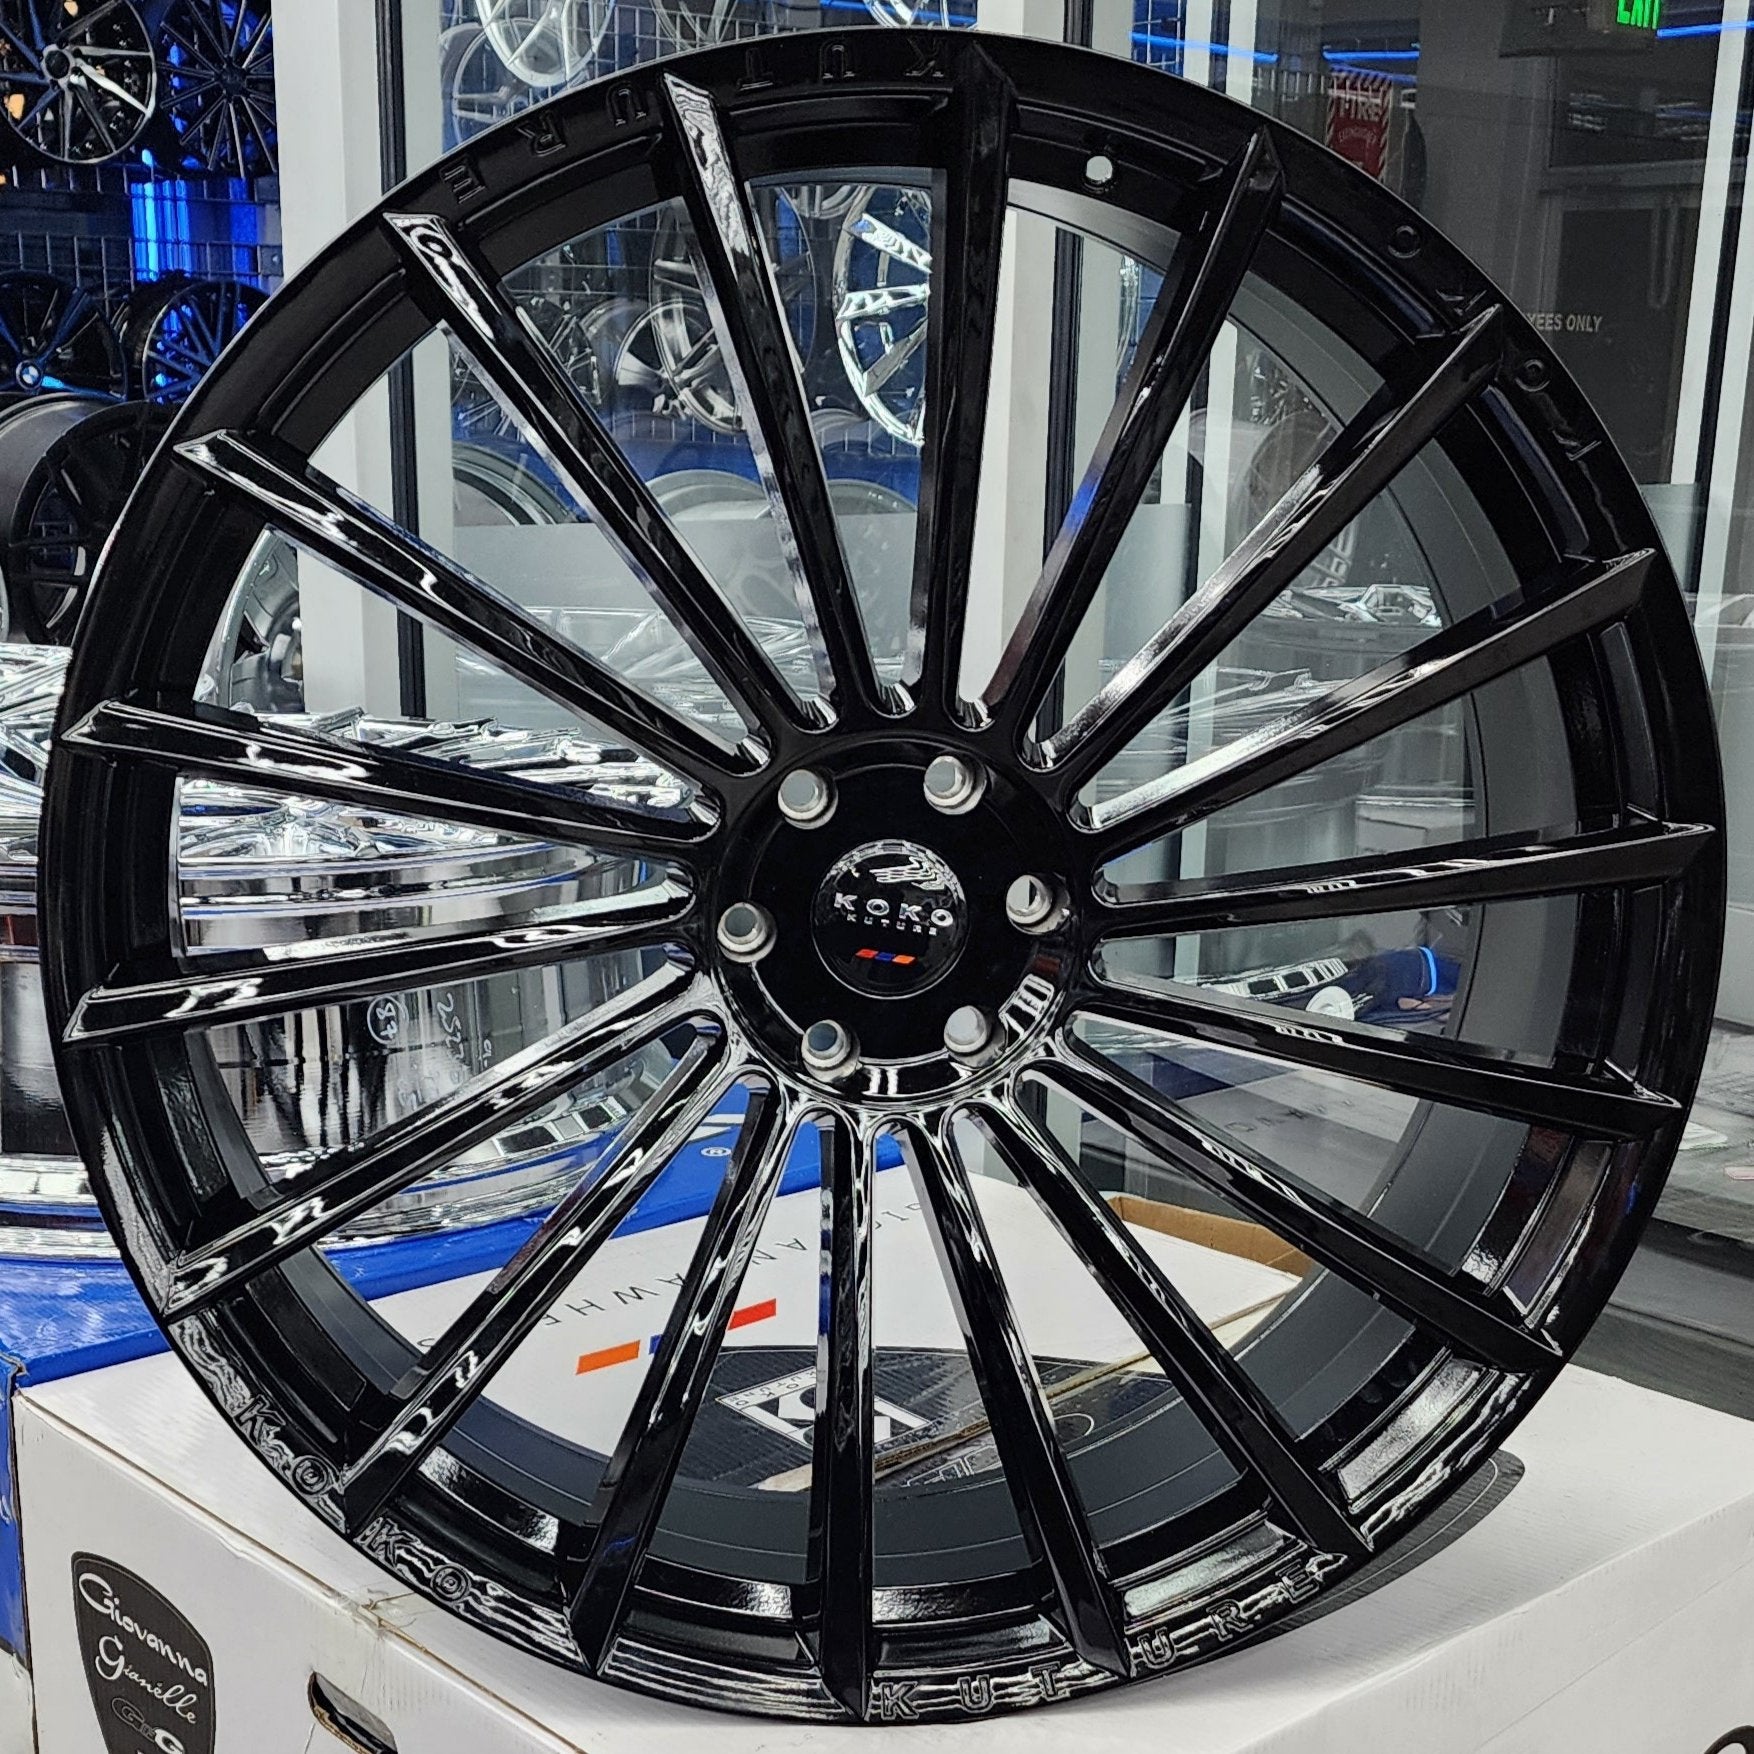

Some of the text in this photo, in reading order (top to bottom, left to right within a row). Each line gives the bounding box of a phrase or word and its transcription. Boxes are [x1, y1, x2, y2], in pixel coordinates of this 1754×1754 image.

[1566, 313, 1603, 333] ONLY
[833, 892, 954, 928] KOKO
[78, 1572, 208, 1686] Giovanna
[880, 1560, 1322, 1721] KUTURE
